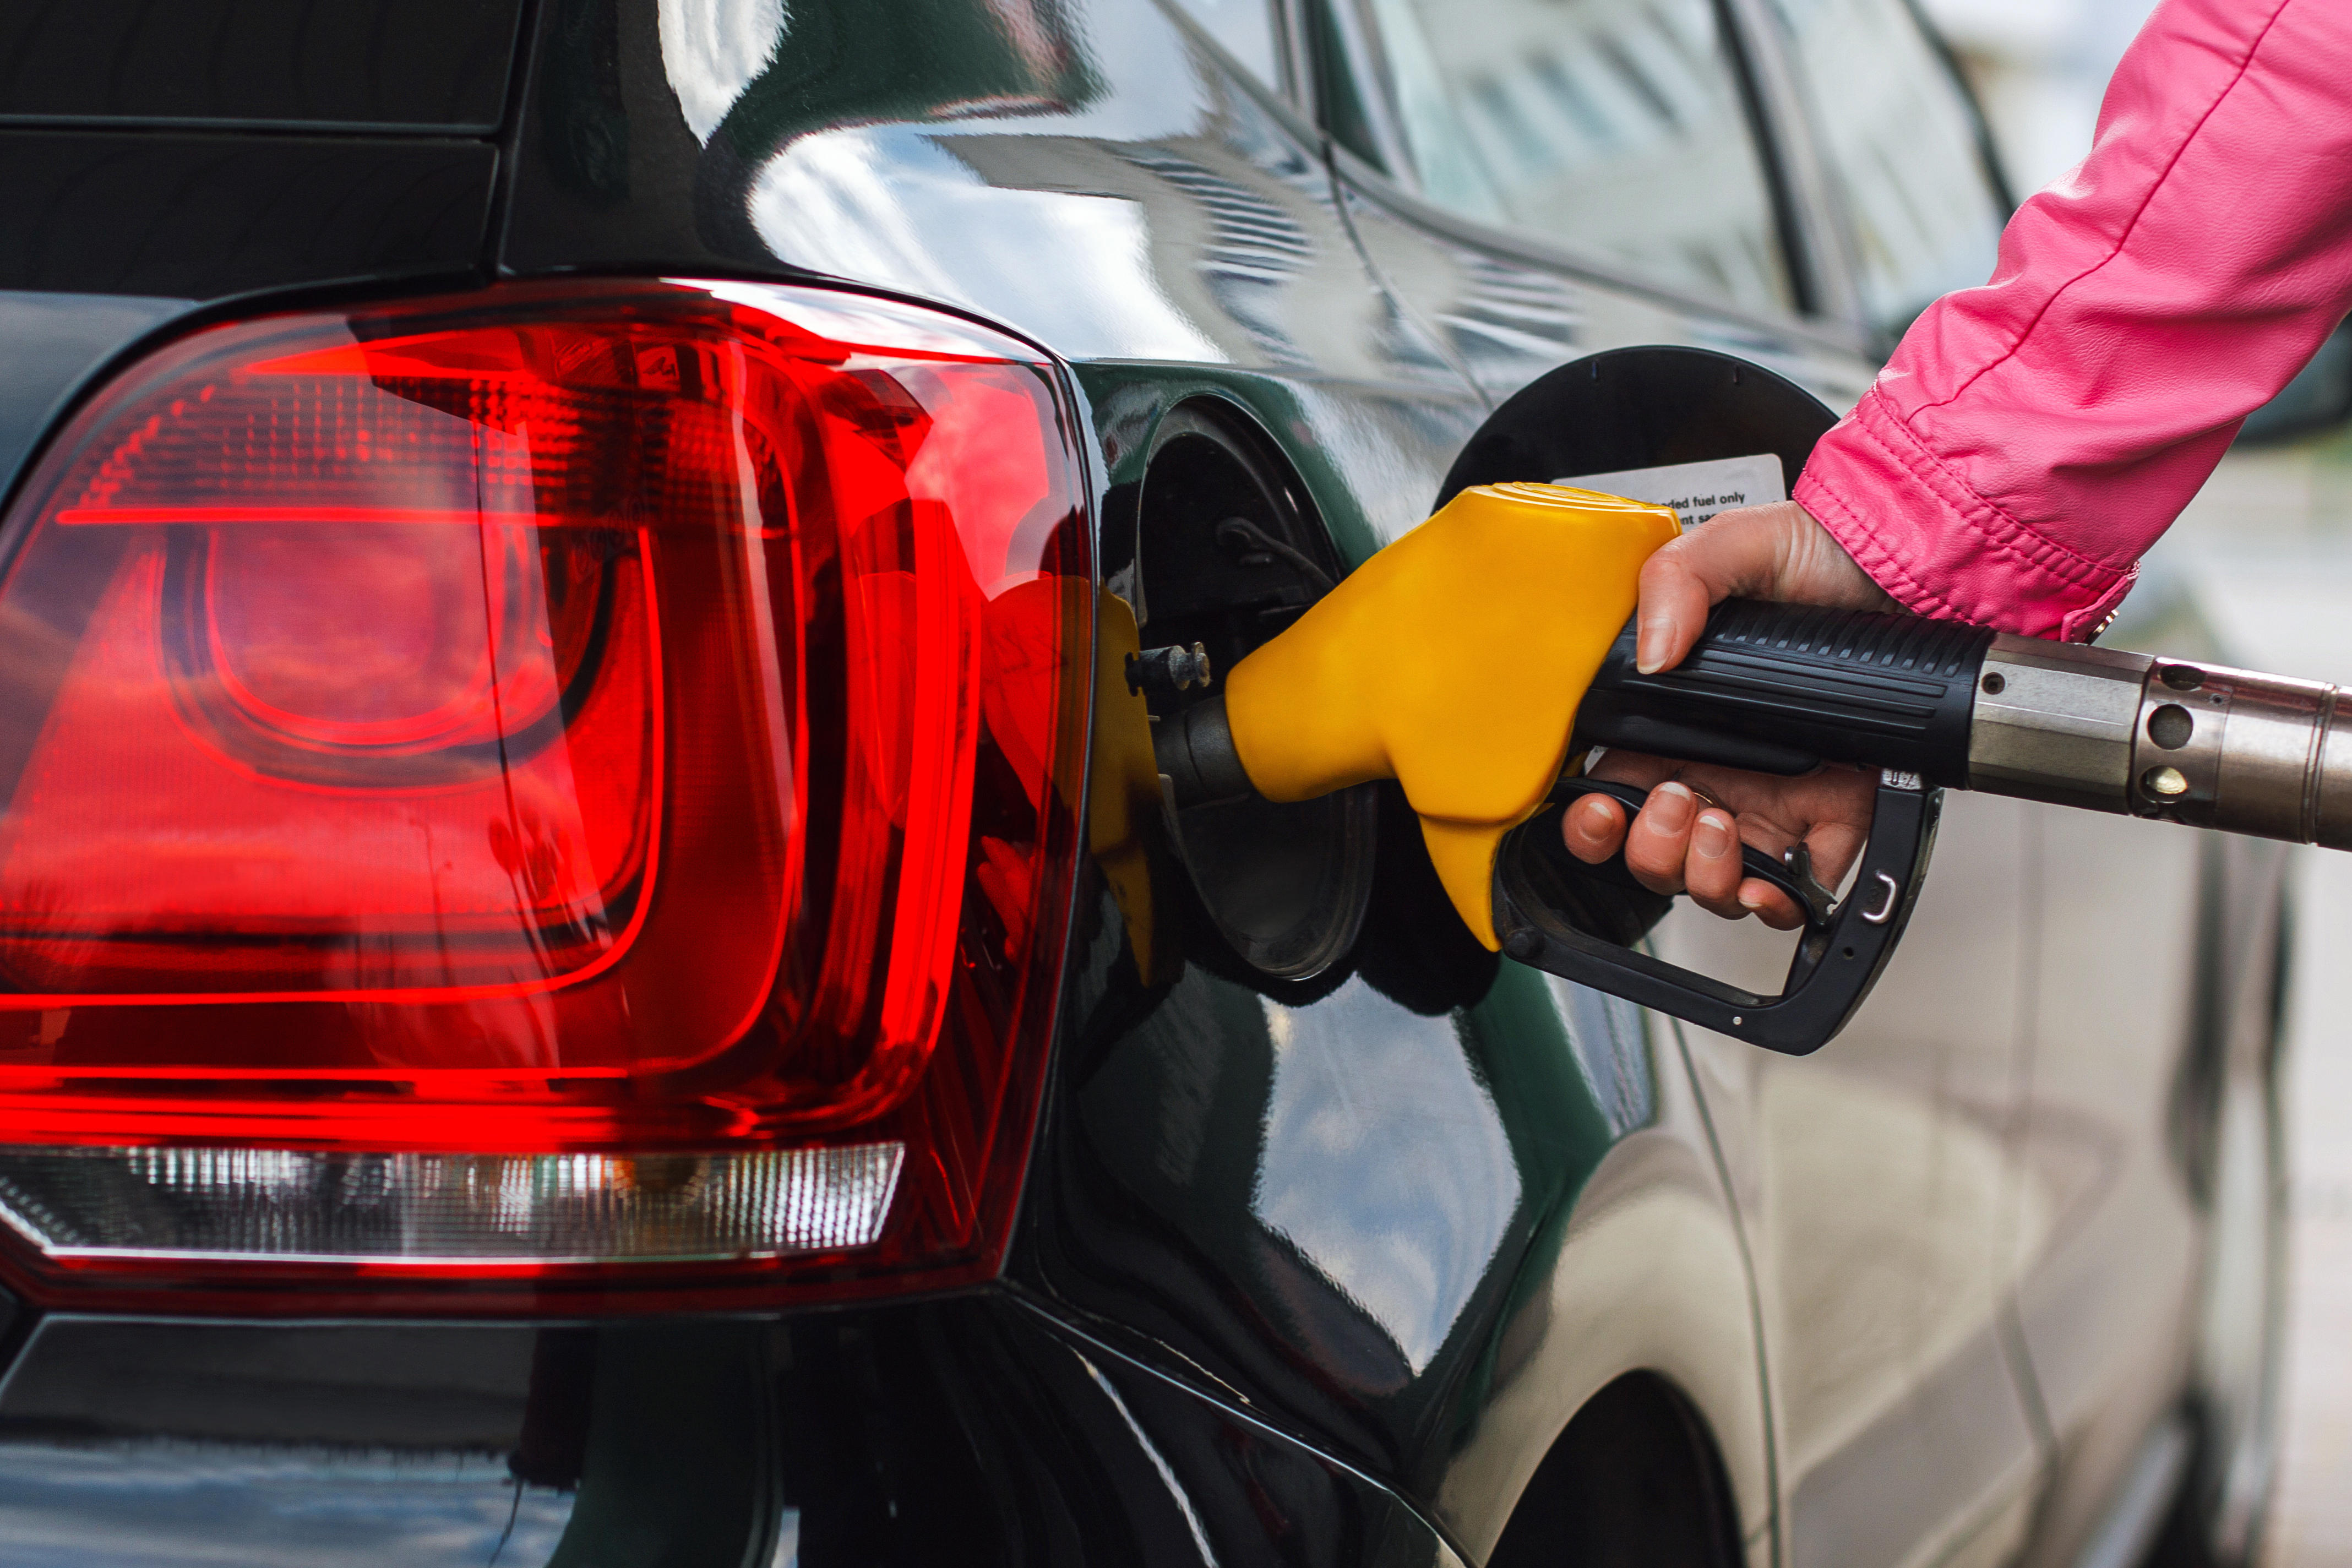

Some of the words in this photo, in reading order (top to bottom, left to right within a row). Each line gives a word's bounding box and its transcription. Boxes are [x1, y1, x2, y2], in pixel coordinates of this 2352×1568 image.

[1662, 497, 1689, 509] ded
[1693, 494, 1716, 507] fuel
[1719, 492, 1745, 504] only
[1680, 515, 1694, 525] nt
